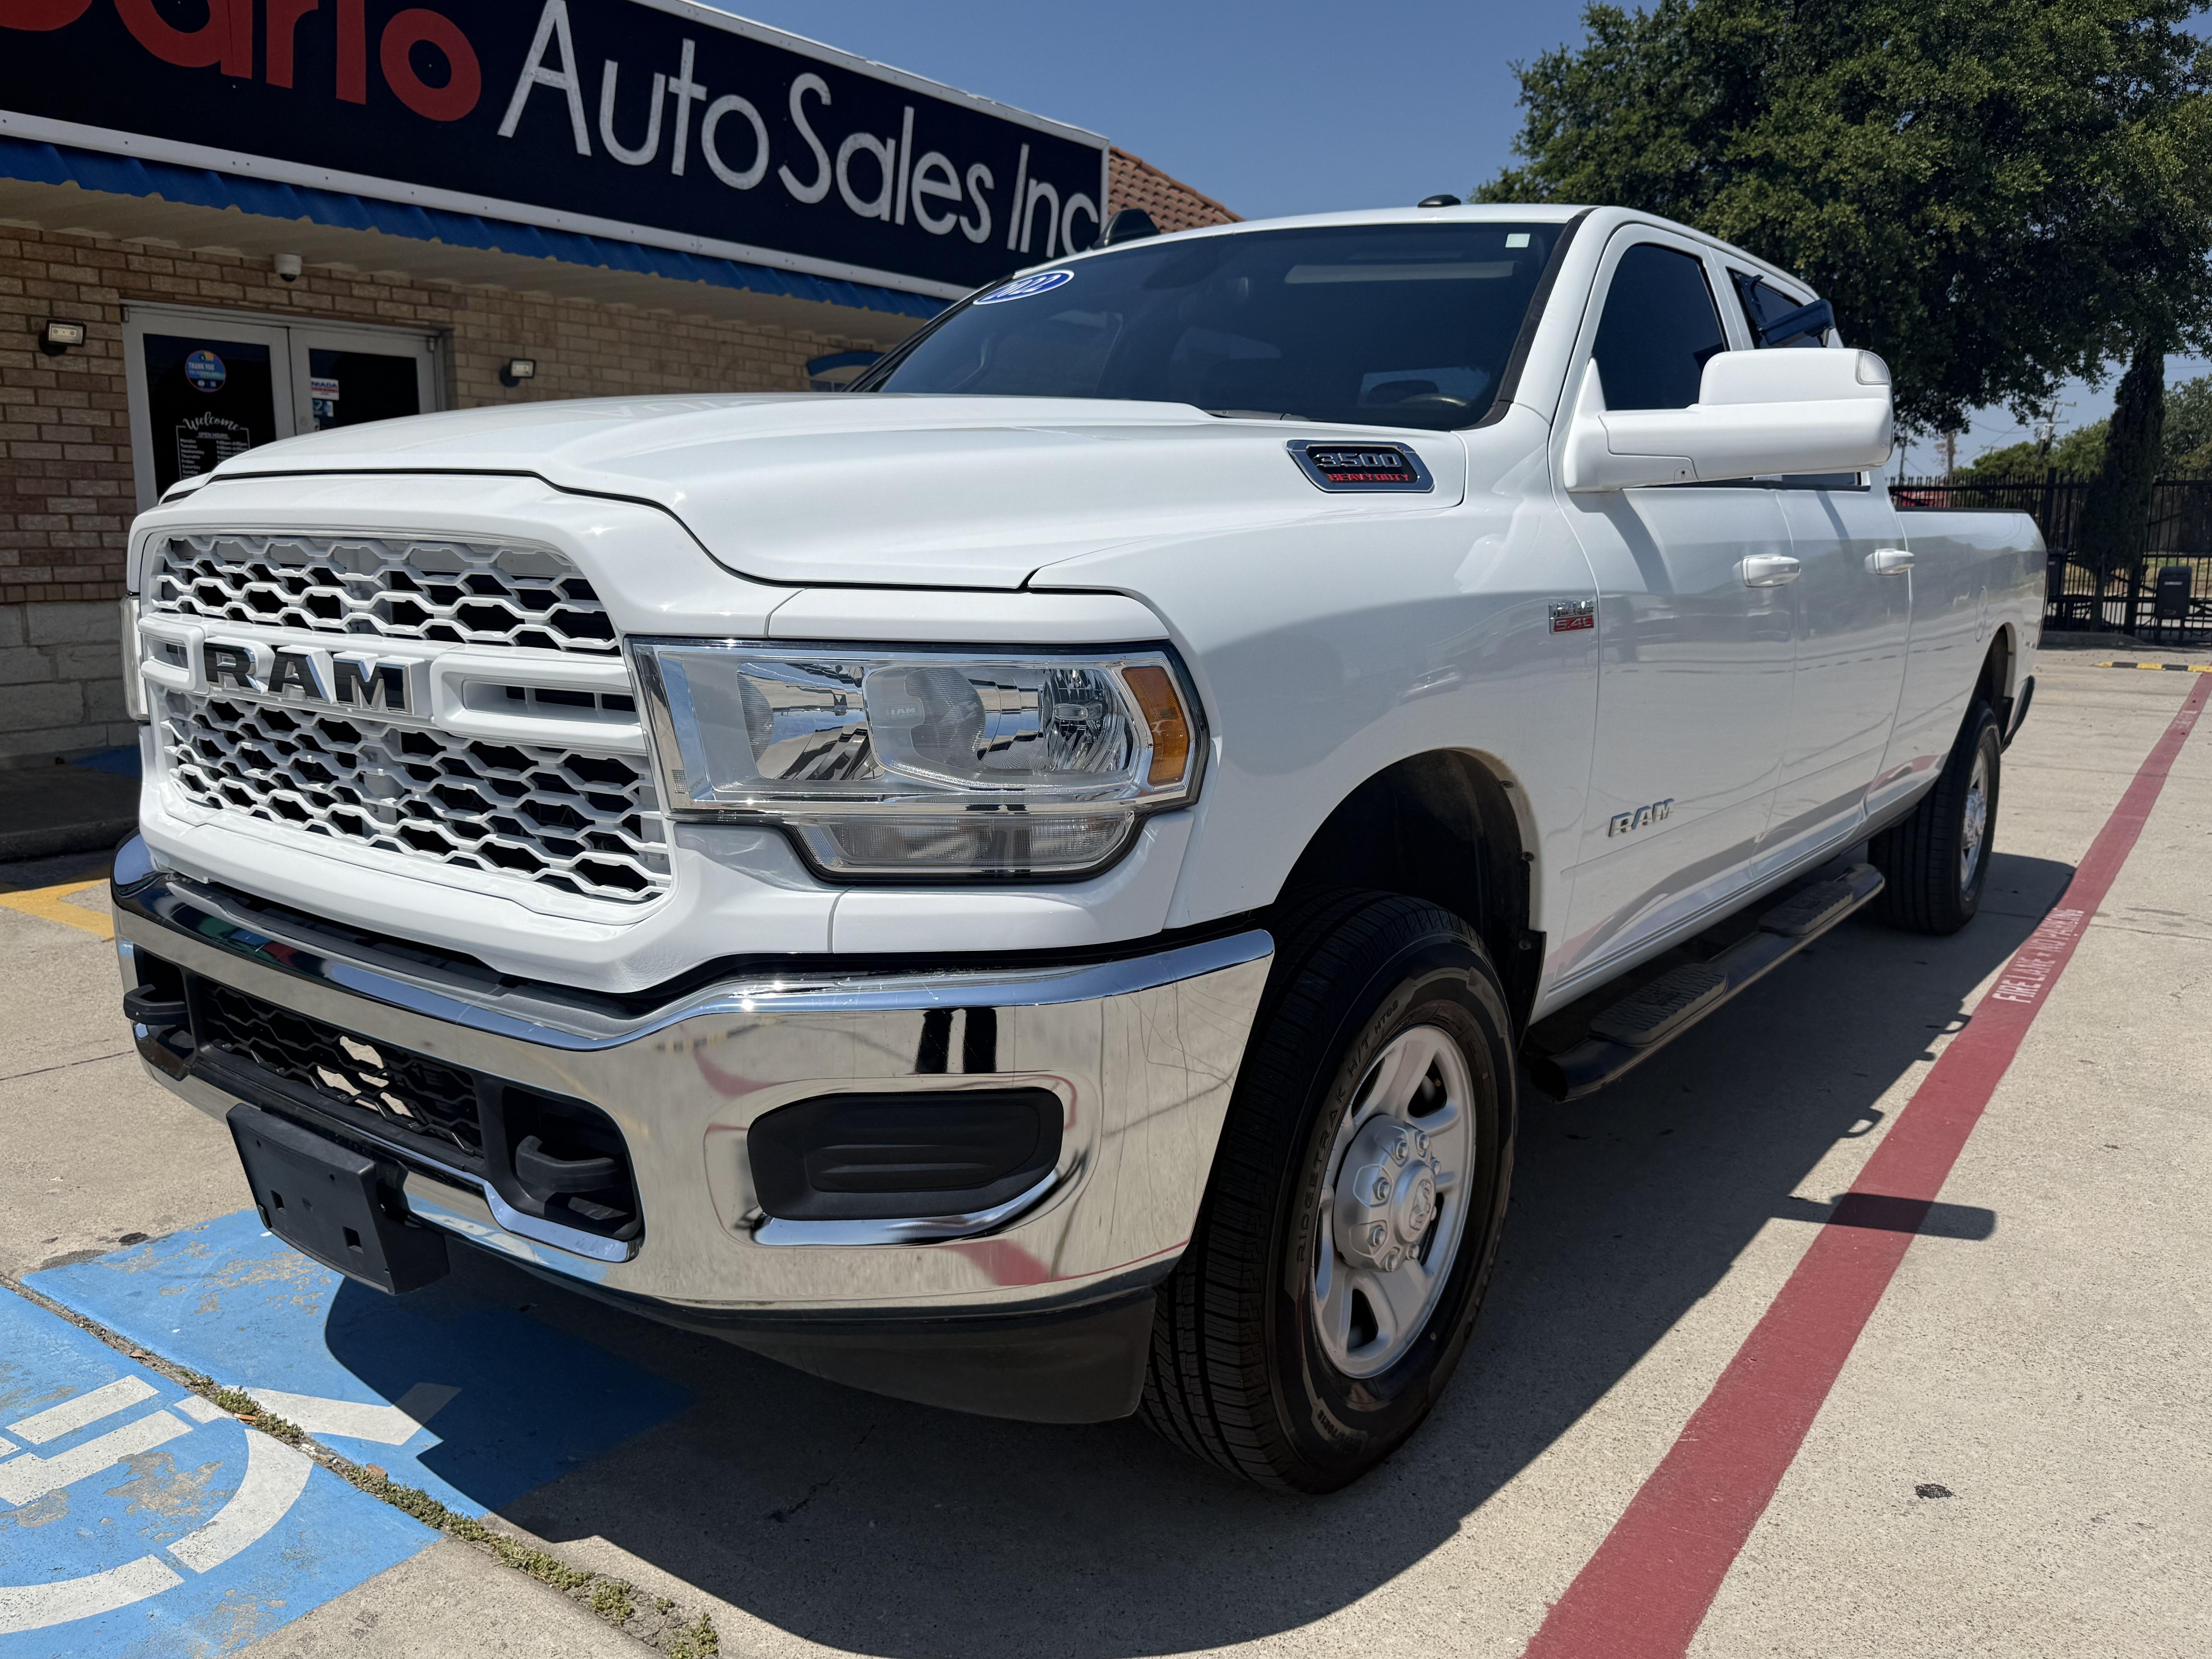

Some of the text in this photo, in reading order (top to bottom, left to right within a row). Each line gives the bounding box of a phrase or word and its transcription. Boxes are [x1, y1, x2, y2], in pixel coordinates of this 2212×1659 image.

[0, 0, 1100, 259] arlo Auto Sales Inc
[980, 274, 1063, 302] 2022
[183, 410, 240, 431] Welcome
[1313, 453, 1402, 467] 3500
[1328, 473, 1409, 482] HEAVY DUTY
[203, 638, 420, 716] RAM
[1608, 798, 1674, 837] RAM
[2004, 956, 2056, 982] LANE
[1992, 979, 2042, 1004] FIRE
